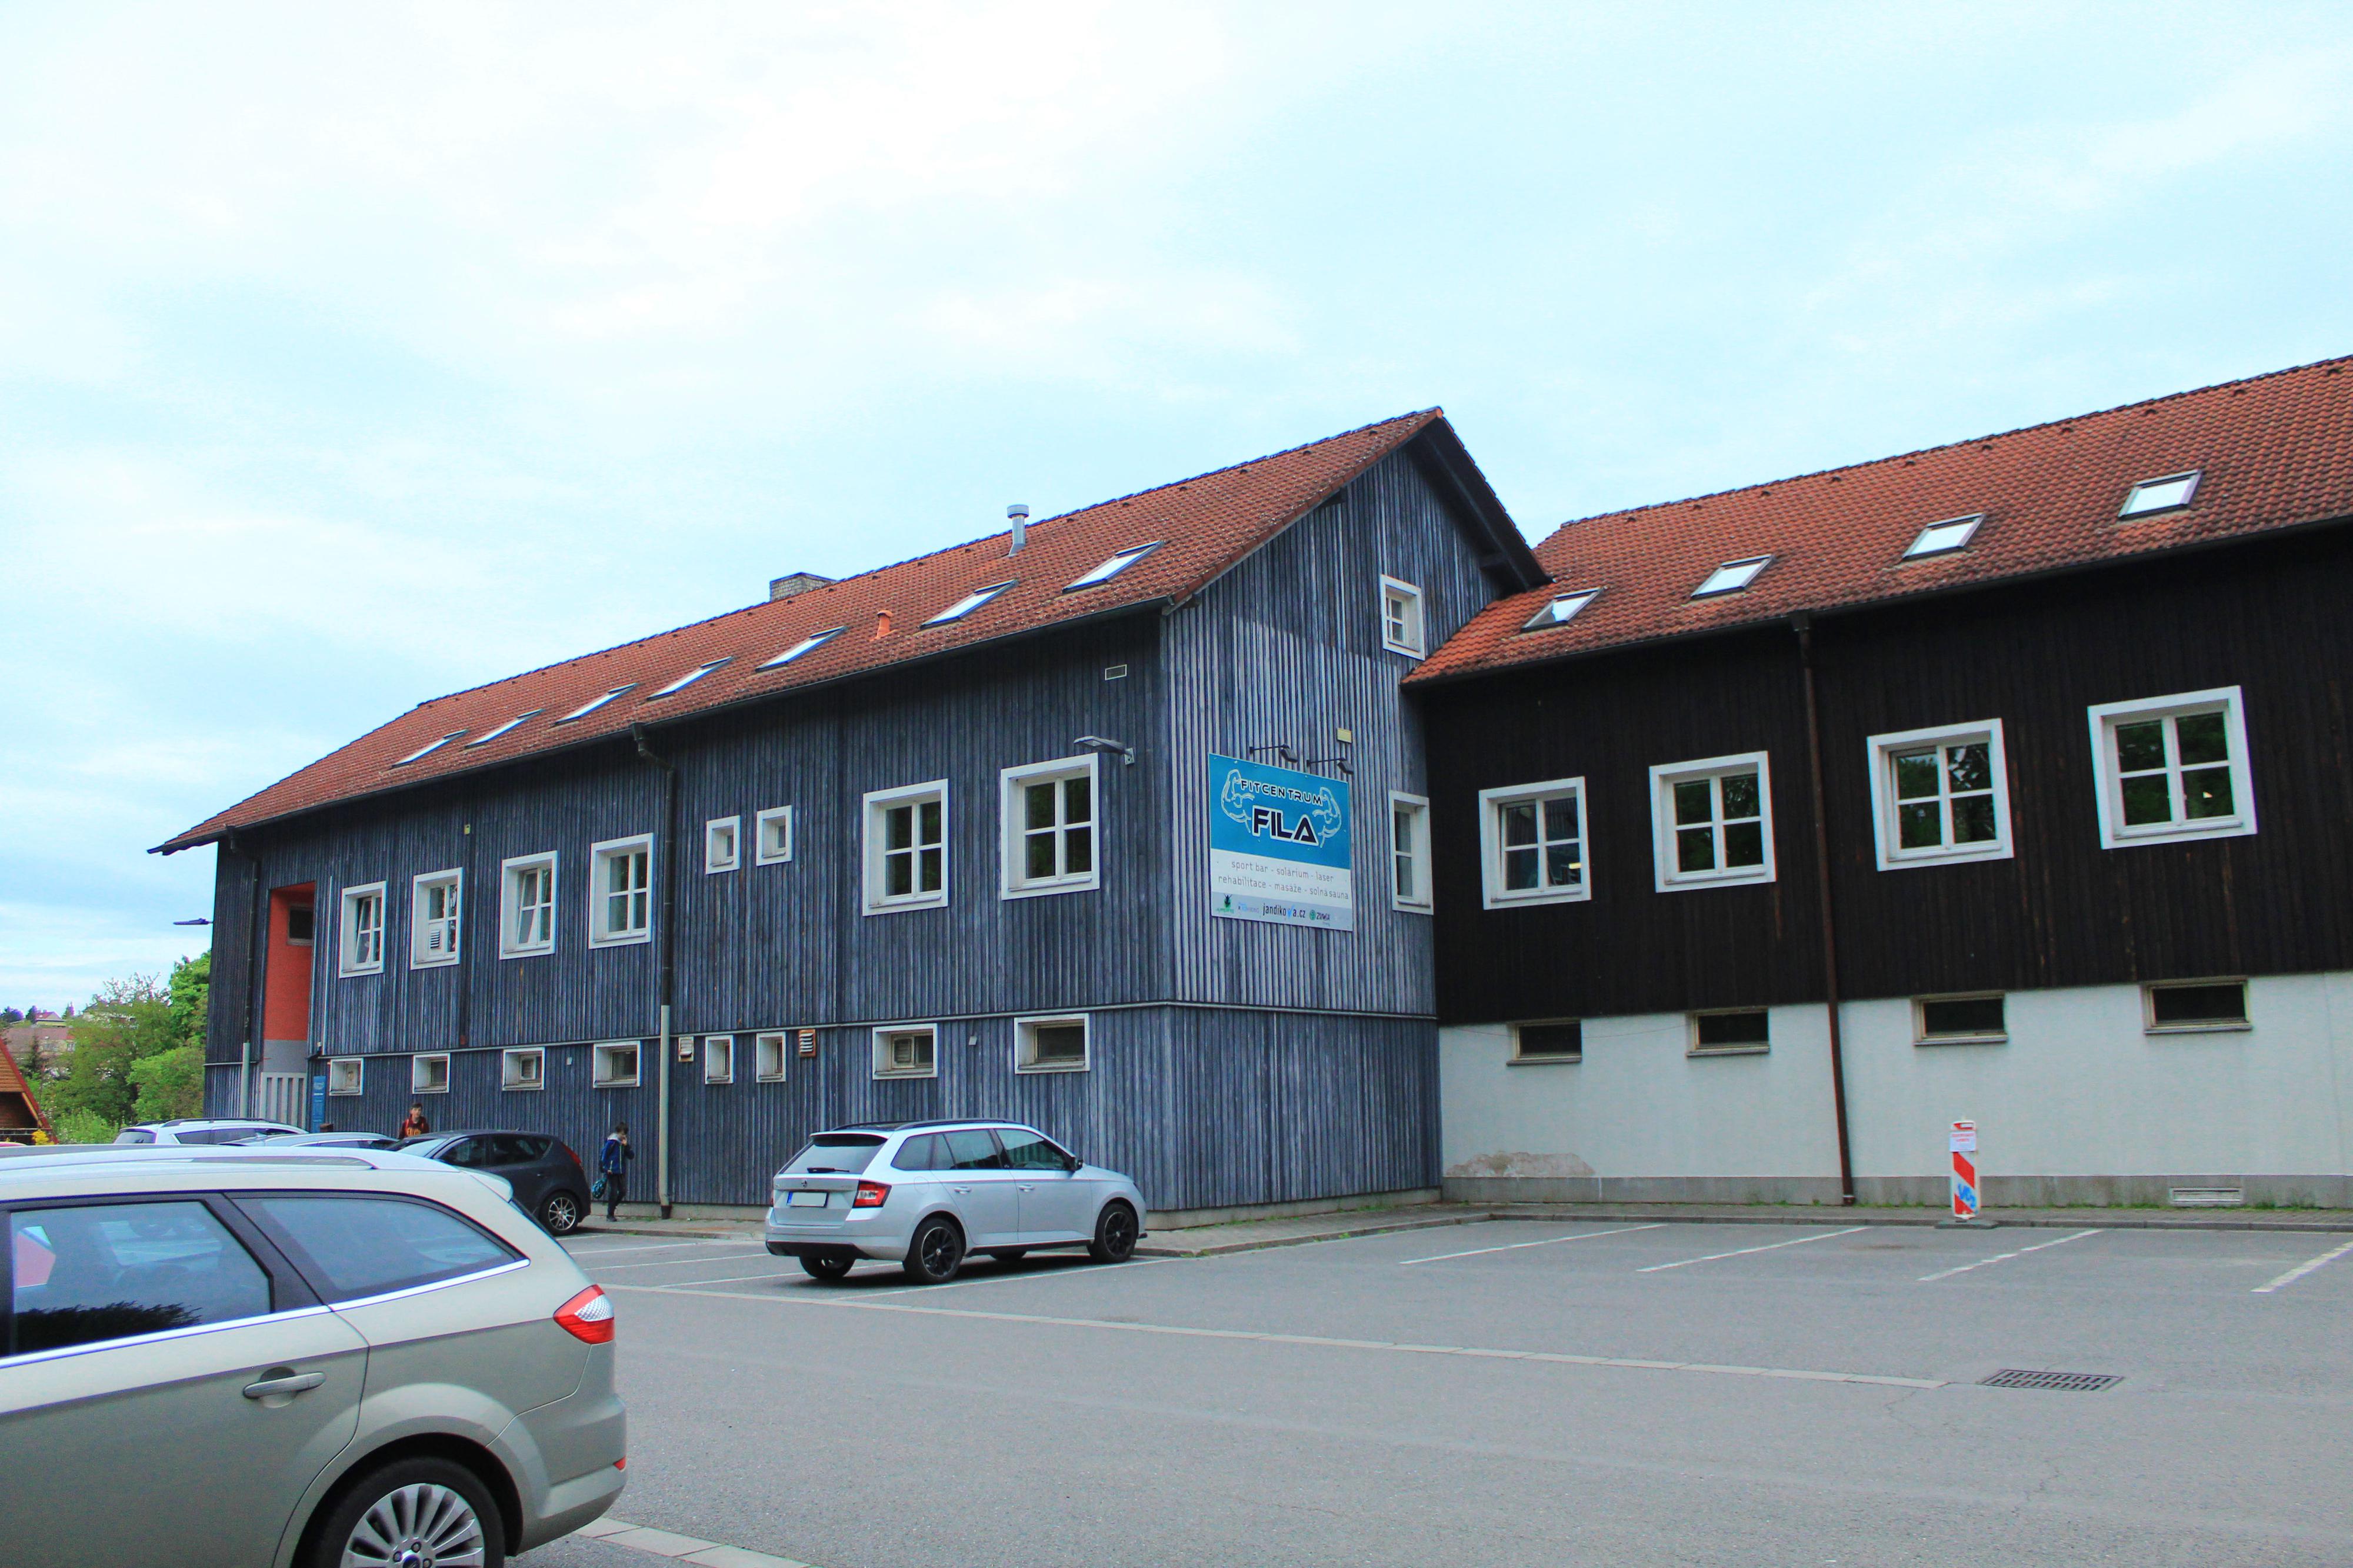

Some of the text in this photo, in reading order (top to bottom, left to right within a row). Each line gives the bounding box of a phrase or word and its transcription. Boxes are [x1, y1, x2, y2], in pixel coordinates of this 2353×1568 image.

[1241, 780, 1322, 805] FITCENTRUM
[1253, 806, 1318, 845] FILA
[1218, 875, 1267, 888] rehabilitace
[1231, 861, 1253, 871] sport
[1255, 862, 1268, 873] bar
[1315, 871, 1334, 882] laser
